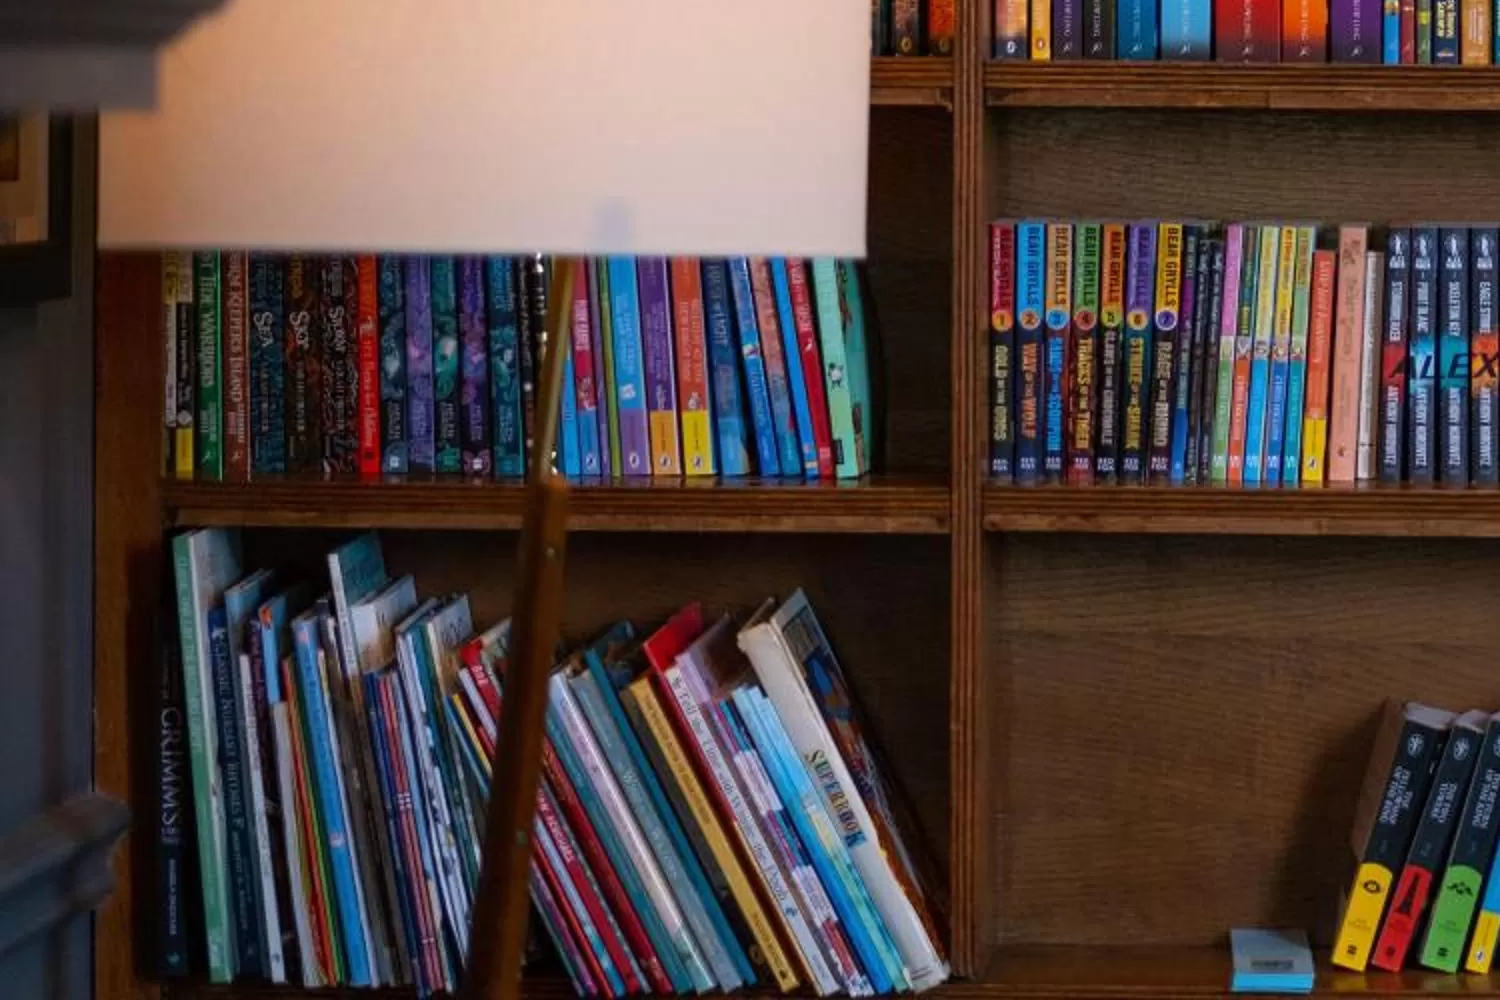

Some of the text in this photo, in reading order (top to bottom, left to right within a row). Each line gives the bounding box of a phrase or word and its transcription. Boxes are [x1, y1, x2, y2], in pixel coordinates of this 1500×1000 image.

[1165, 227, 1178, 307] BEAR GRYLLS
[1021, 397, 1035, 439] WOLF
[1387, 385, 1398, 421] ANTHONY
[1448, 387, 1460, 422] ANTHONY
[1480, 387, 1491, 422] ANTHONY
[159, 706, 181, 826] GRIMM'S
